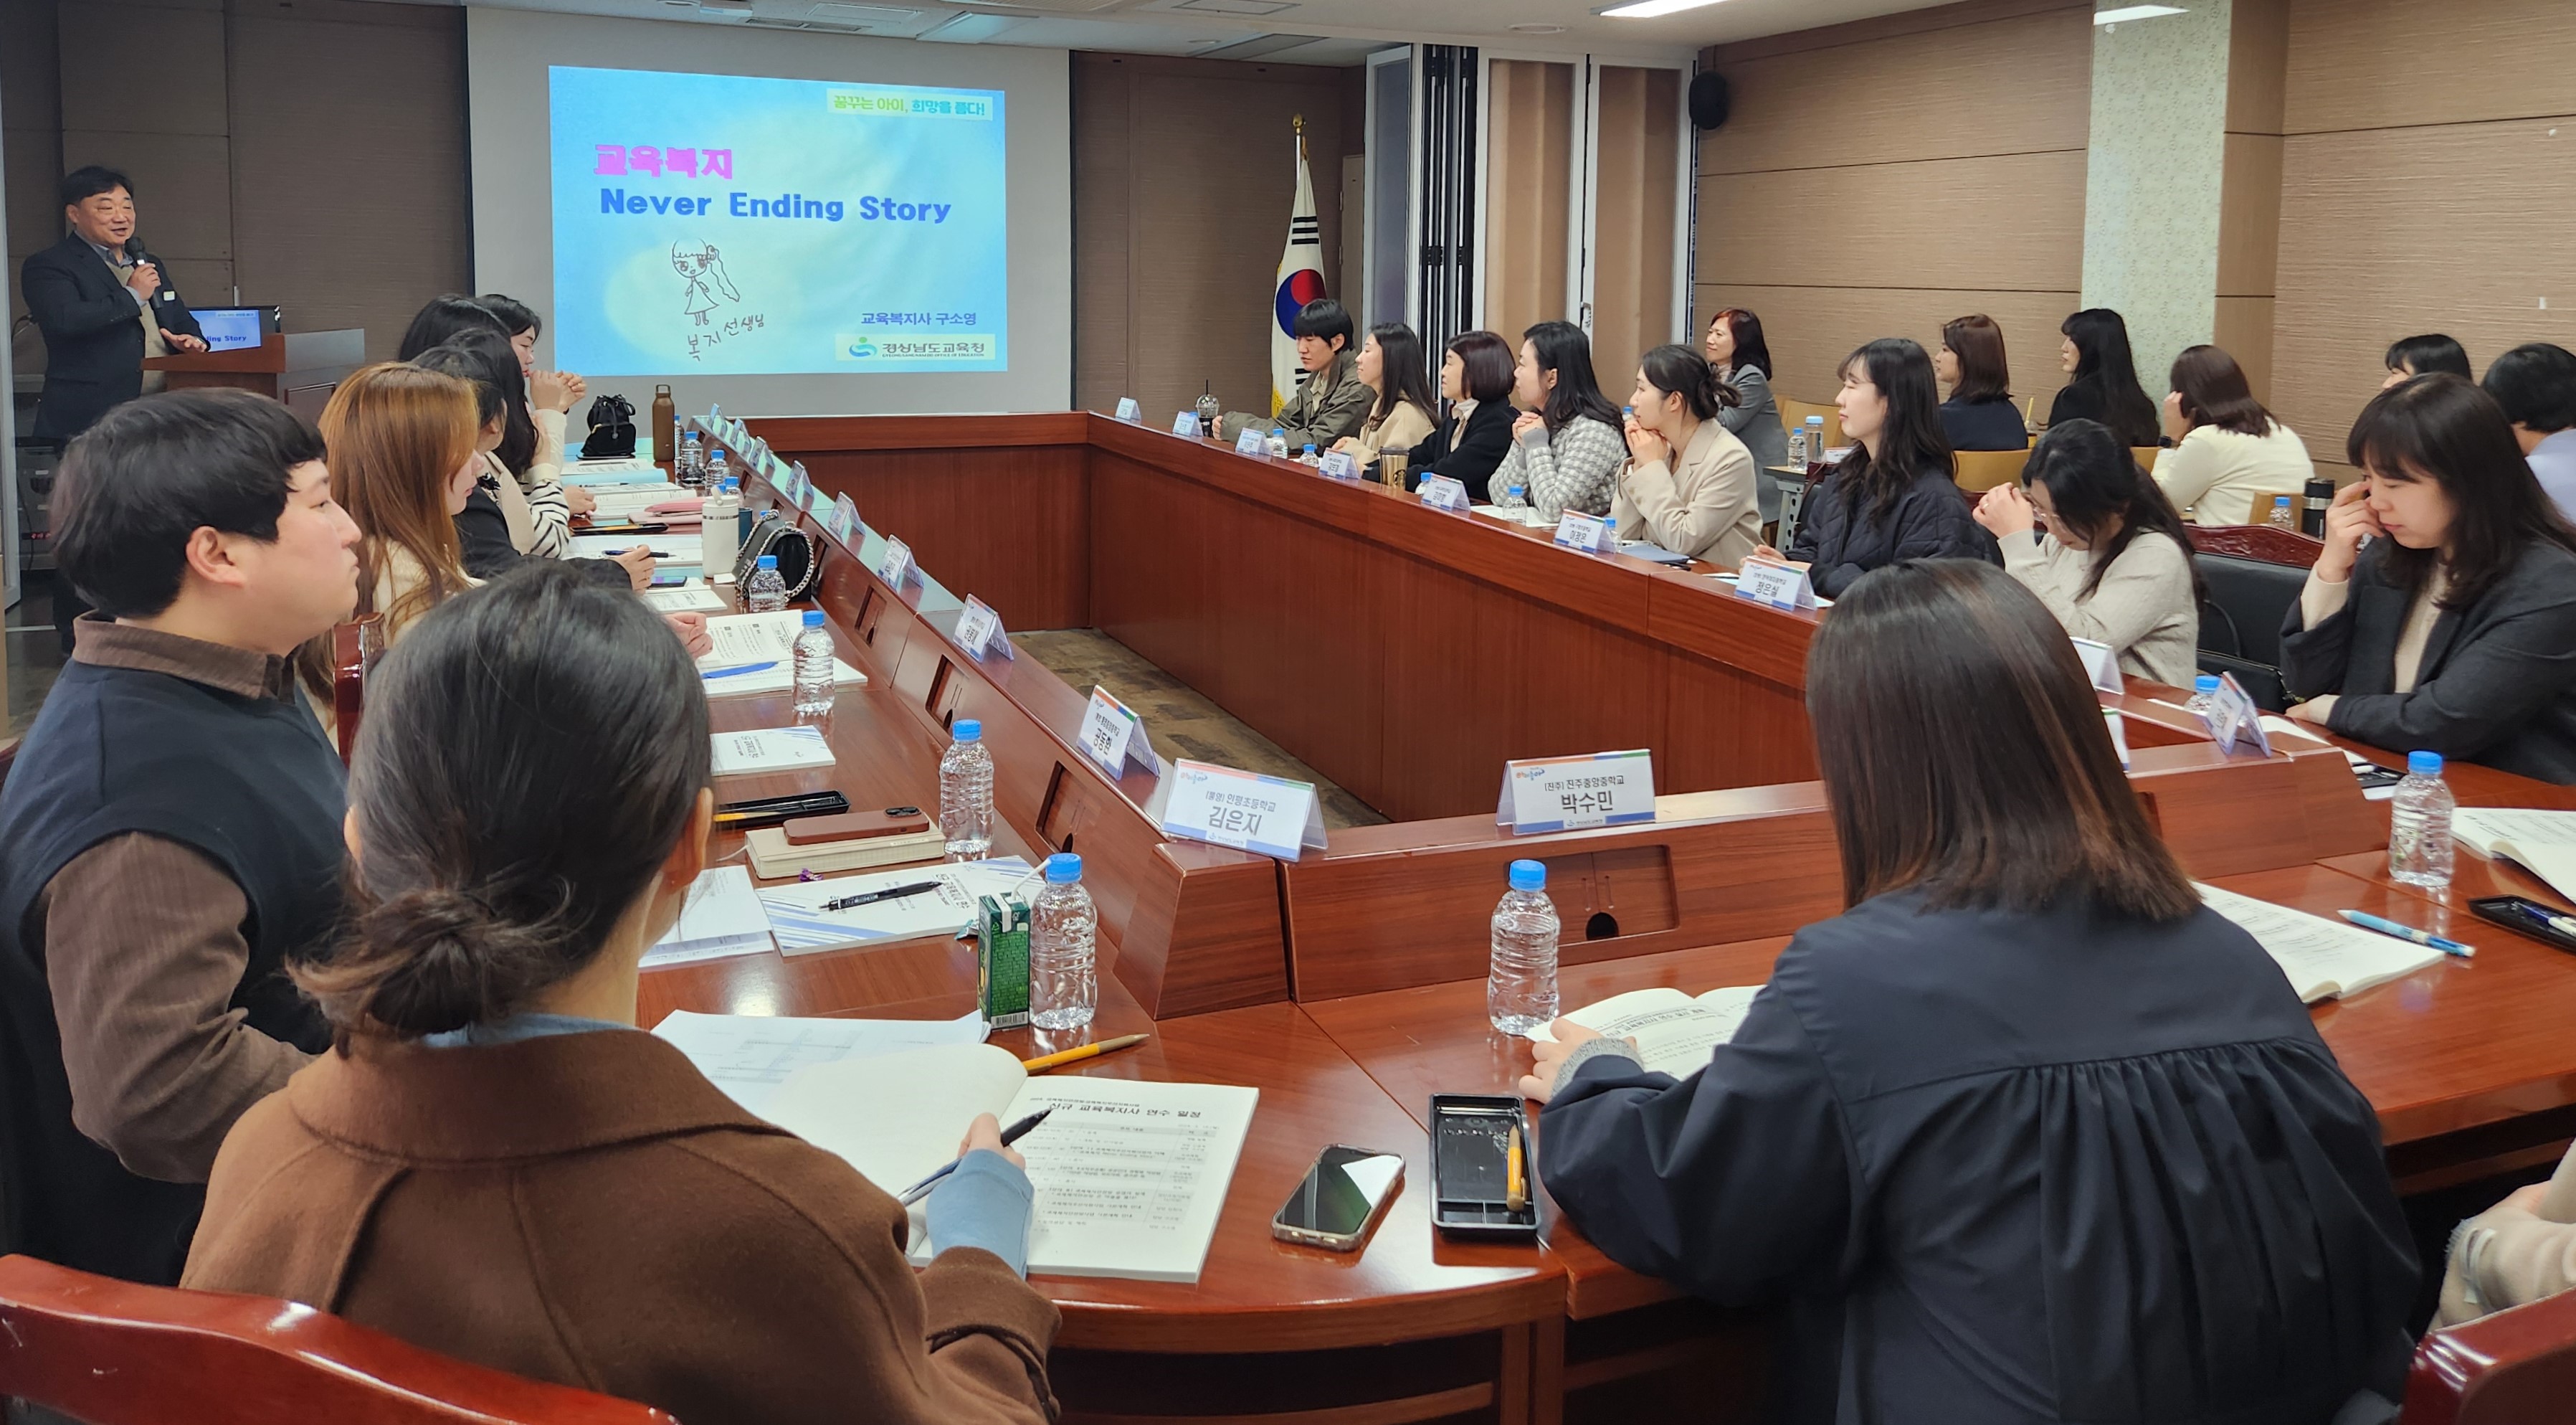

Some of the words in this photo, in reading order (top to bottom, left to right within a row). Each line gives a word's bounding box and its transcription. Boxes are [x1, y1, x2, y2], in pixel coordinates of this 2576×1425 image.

[834, 95, 874, 110] 꿈꾸는
[876, 98, 908, 113] 아이,
[594, 144, 733, 179] 교육복지
[601, 188, 711, 216] Never
[729, 193, 844, 222] Ending
[860, 197, 951, 223] Story
[860, 312, 932, 326] 교육복지사
[935, 312, 977, 326] 구소영
[883, 342, 985, 354] 경상남도교육청
[1544, 781, 1564, 792] [진주]
[1566, 775, 1625, 790] 진주중앙중학교
[1226, 793, 1276, 813] 인평초등학교
[1561, 790, 1614, 815] 박수민
[1209, 805, 1263, 836] 김은지
[1079, 1105, 1140, 1115] 교육복지사
